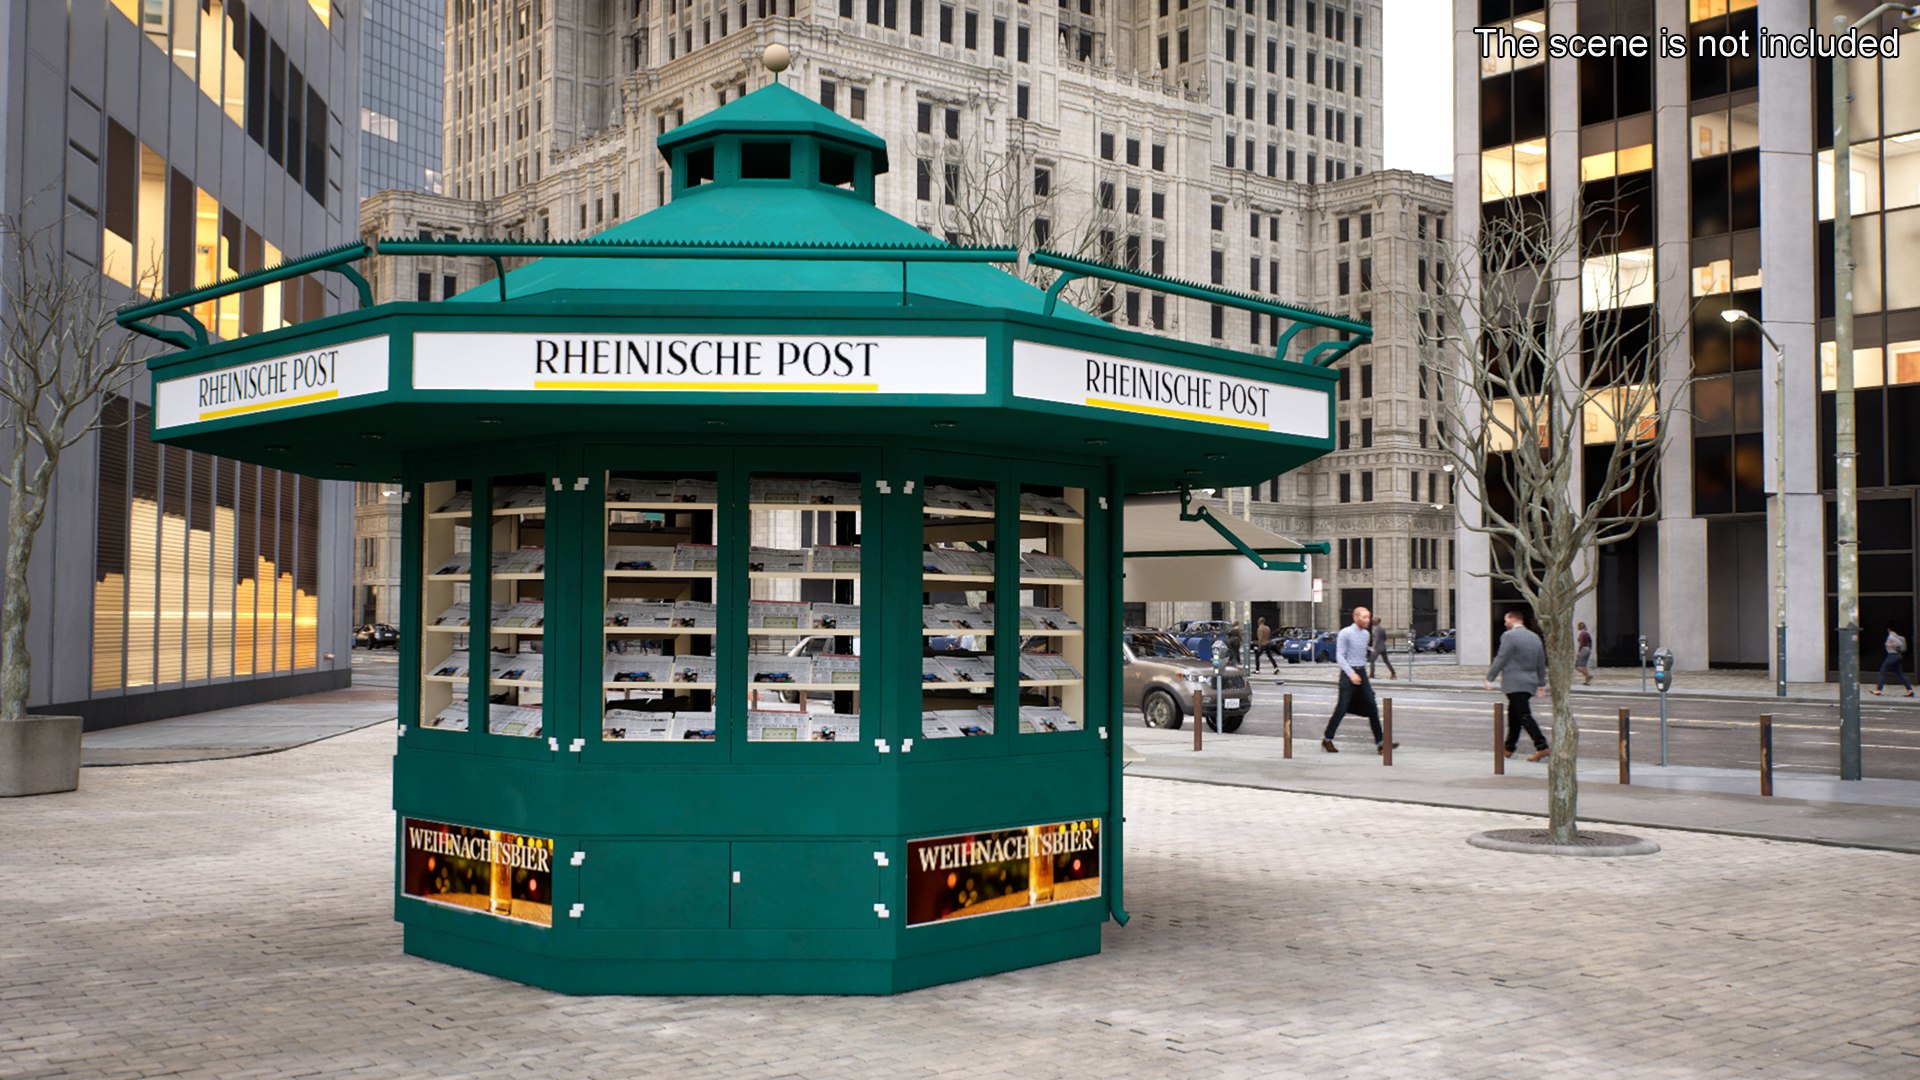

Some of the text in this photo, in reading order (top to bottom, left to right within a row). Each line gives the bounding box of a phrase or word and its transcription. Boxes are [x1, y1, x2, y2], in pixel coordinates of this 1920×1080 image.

[199, 350, 340, 408] RHEINISCHE POST
[535, 339, 880, 377] RHEINISCHE POST
[1086, 359, 1270, 418] RHEINISCHE POST
[408, 827, 551, 873] WEIHNACHTSBIER
[918, 829, 1095, 873] WEIHNACHTSBIER
